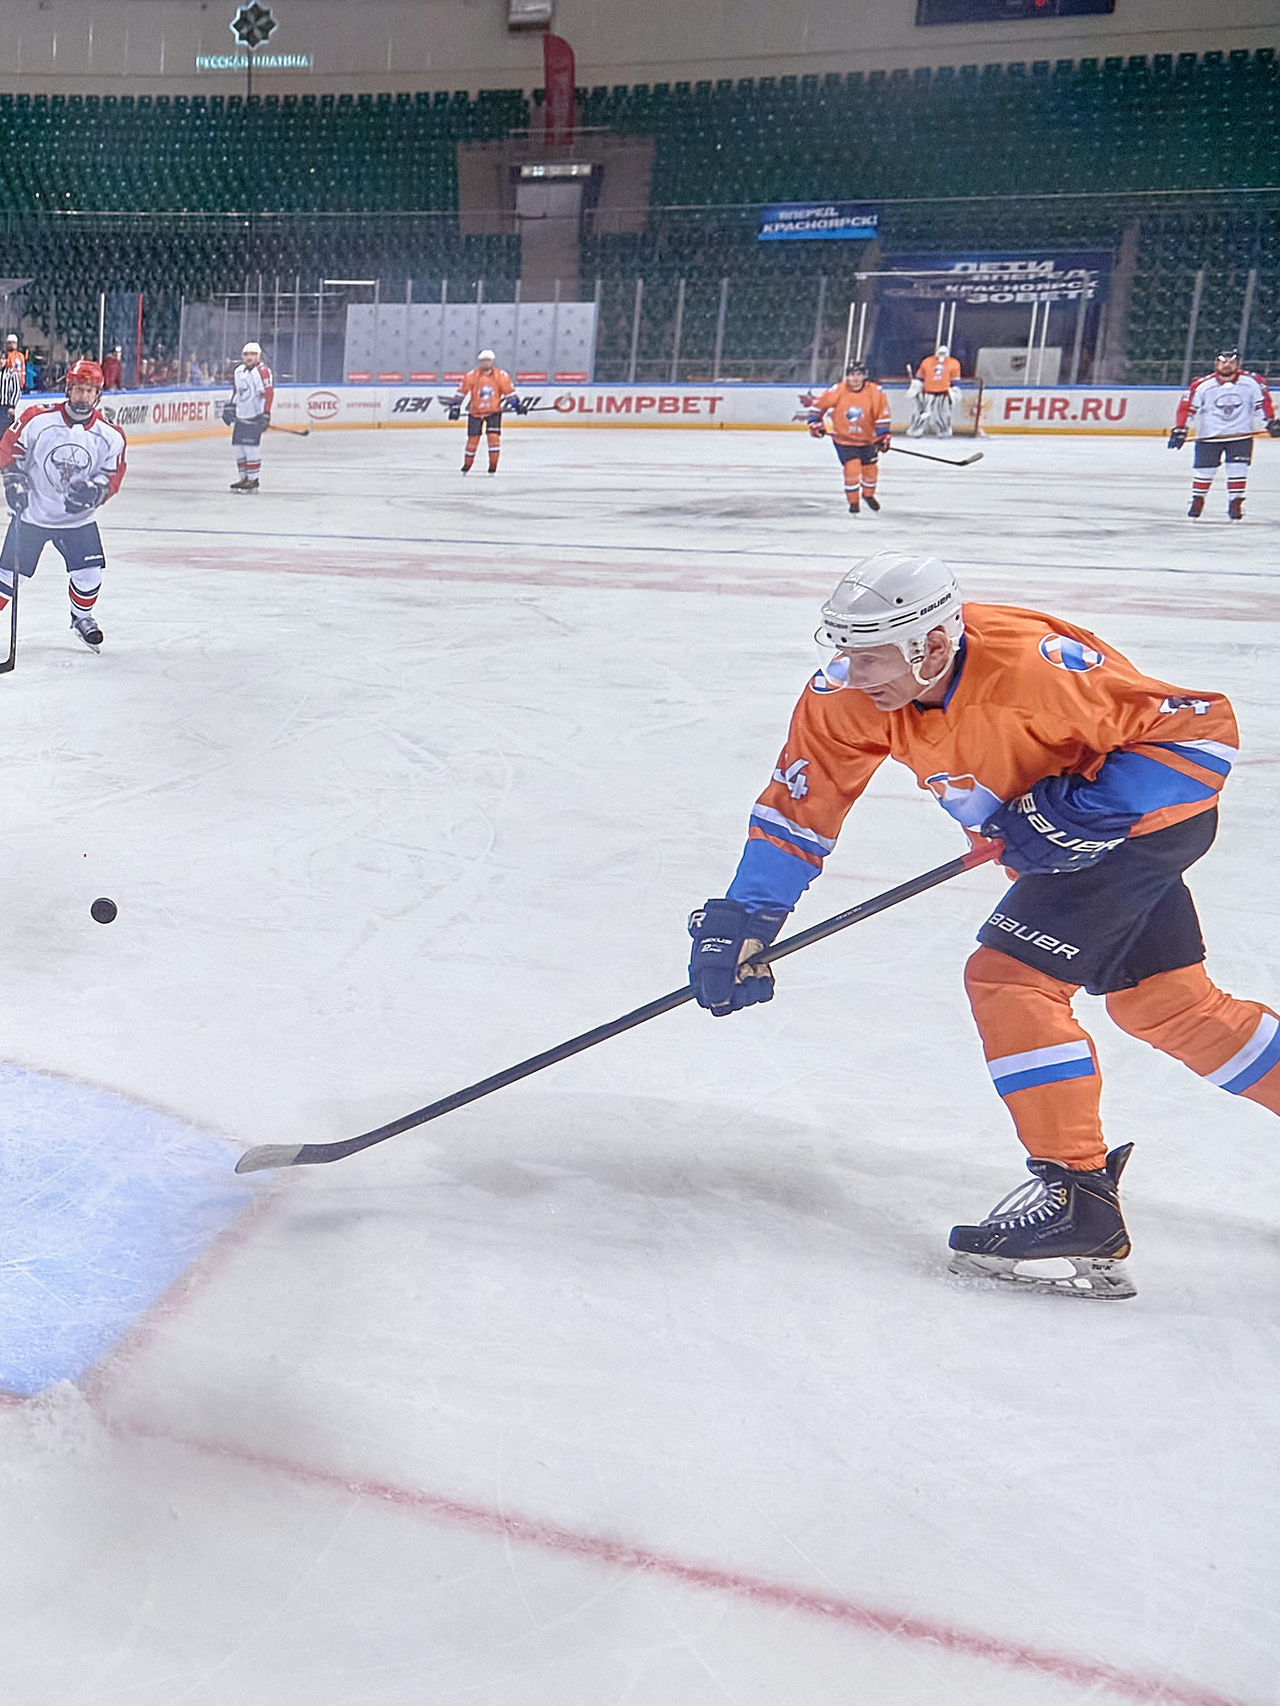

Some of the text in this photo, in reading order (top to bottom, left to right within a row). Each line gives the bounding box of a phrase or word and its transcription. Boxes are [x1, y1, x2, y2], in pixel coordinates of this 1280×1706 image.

[152, 401, 211, 424] OLIMPBET
[308, 401, 338, 410] SINTEC
[553, 396, 724, 414] OLIMPBET
[1004, 397, 1128, 421] FHR.RU
[919, 592, 952, 616] BAUER
[1021, 792, 1126, 853] BAUER
[988, 912, 1081, 960] BAUER
